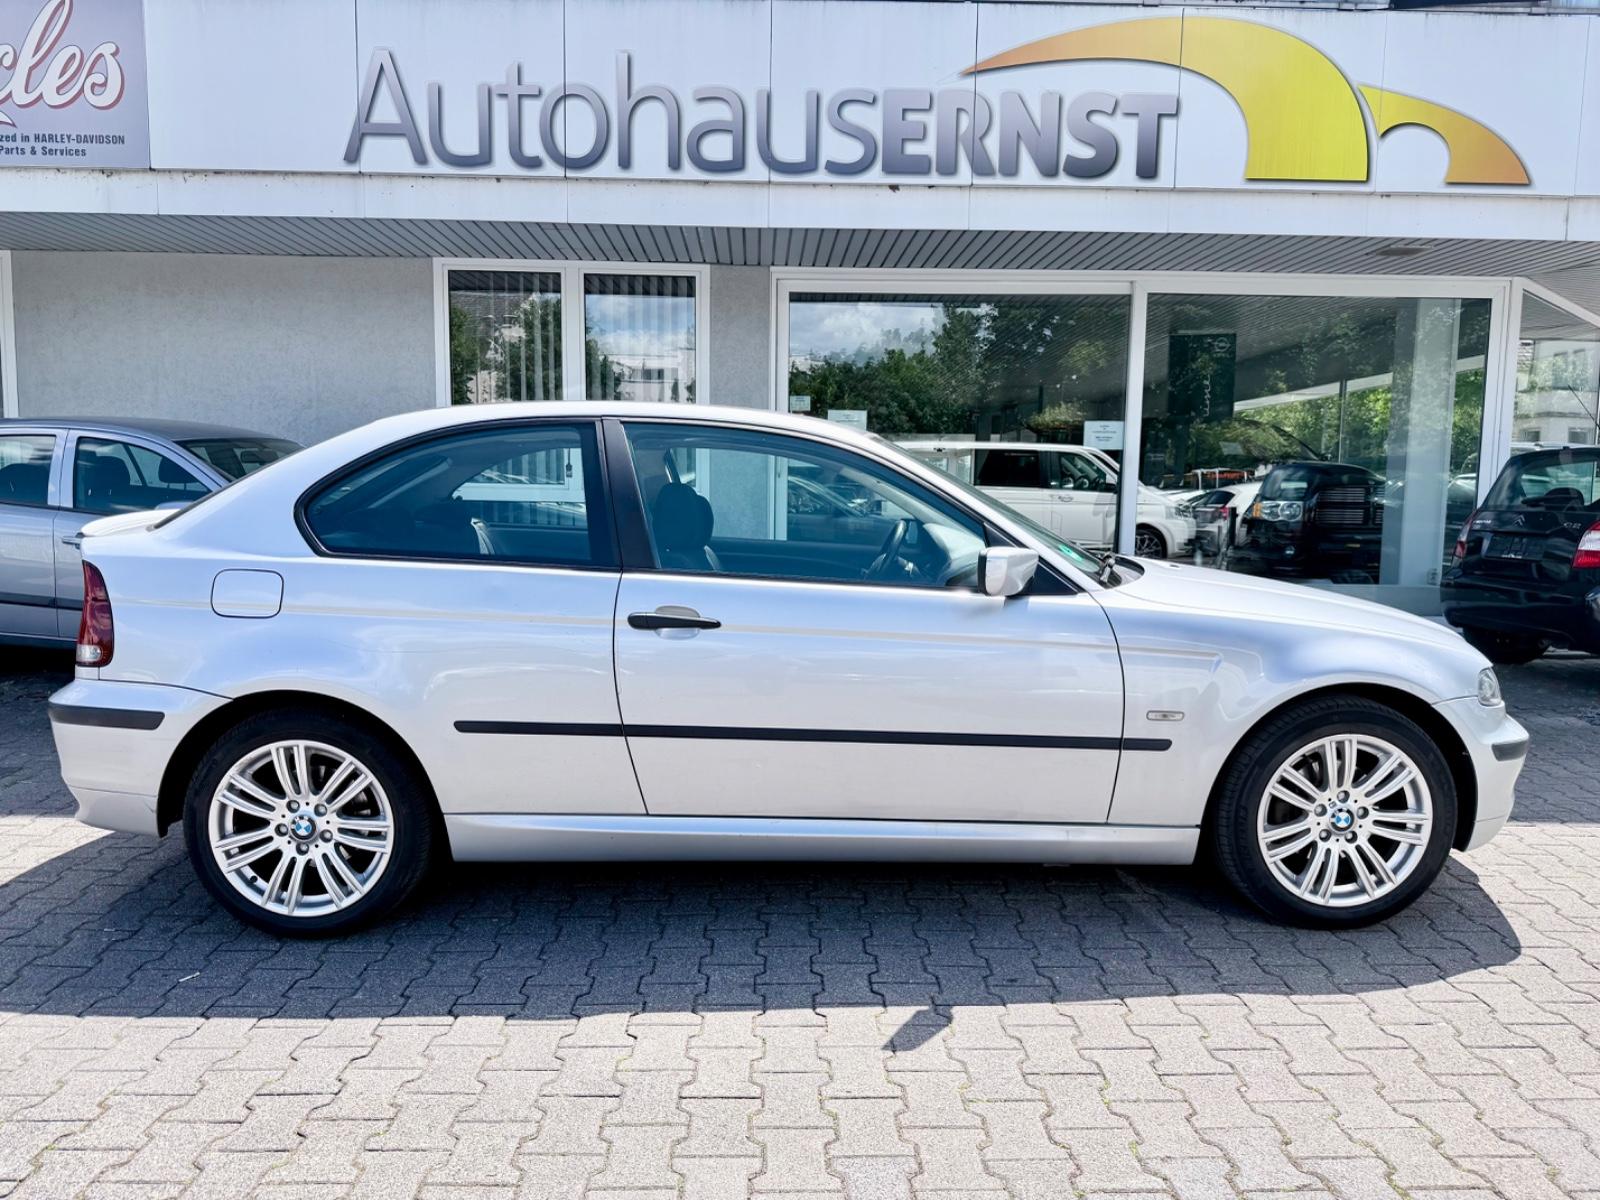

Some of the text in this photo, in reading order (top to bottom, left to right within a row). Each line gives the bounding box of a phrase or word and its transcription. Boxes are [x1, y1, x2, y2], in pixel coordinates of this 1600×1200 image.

[21, 132, 30, 143] in
[34, 133, 125, 145] HARLEY-DAVIDSON
[30, 145, 37, 156] &
[41, 146, 87, 157] Services
